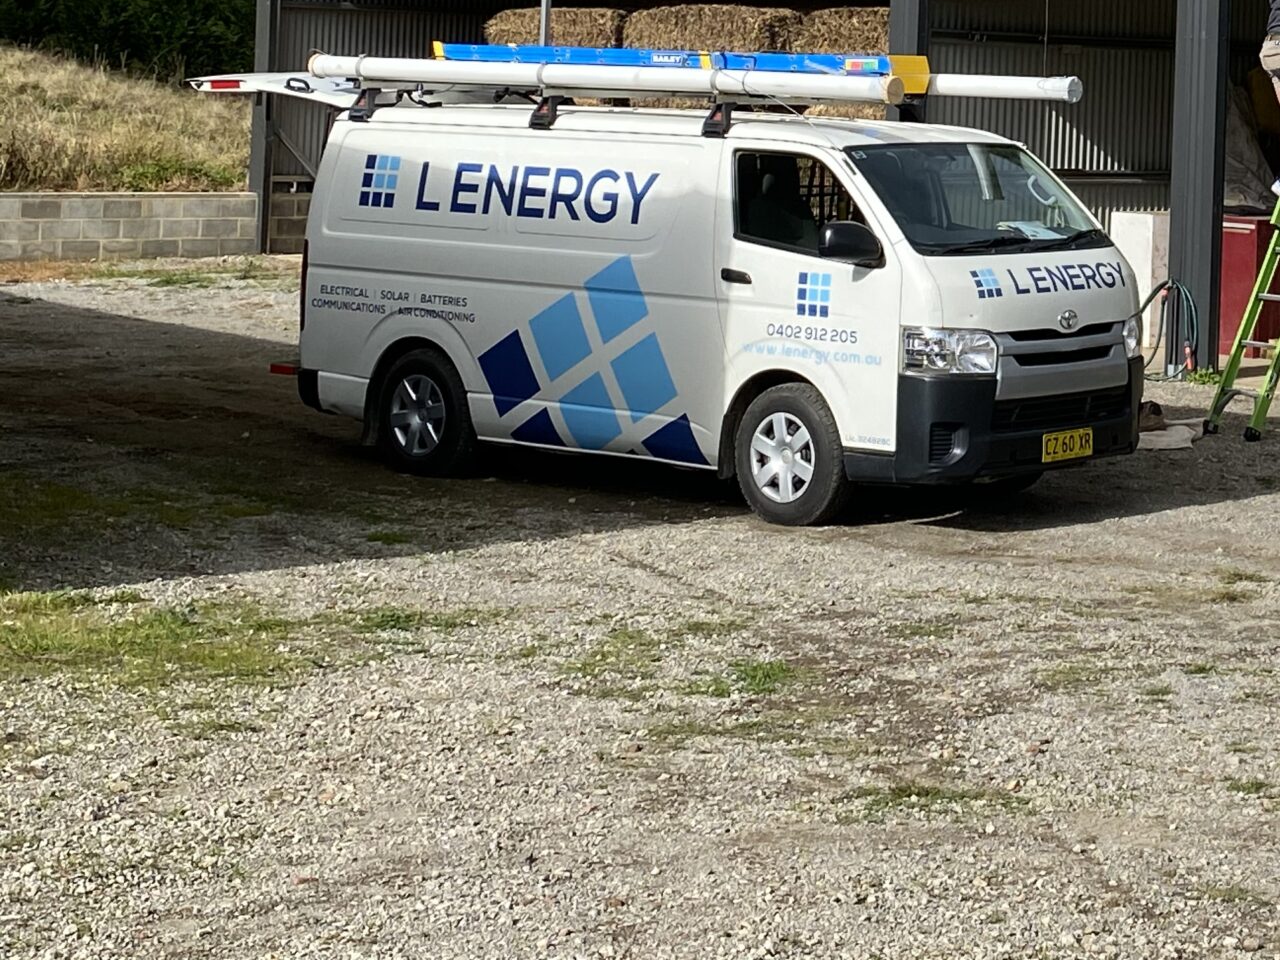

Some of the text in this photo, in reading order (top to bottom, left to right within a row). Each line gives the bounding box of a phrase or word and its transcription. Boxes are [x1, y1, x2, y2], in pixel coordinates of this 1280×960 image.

[415, 161, 661, 225] LENERGY
[1006, 261, 1126, 295] LENERGY
[311, 298, 386, 314] COMMUNICATIONS
[320, 284, 468, 307] ELECTRICAL SOLAR BATTERIES
[767, 323, 858, 344] 0402 912 205
[1045, 432, 1091, 456] CZ 60 XR
